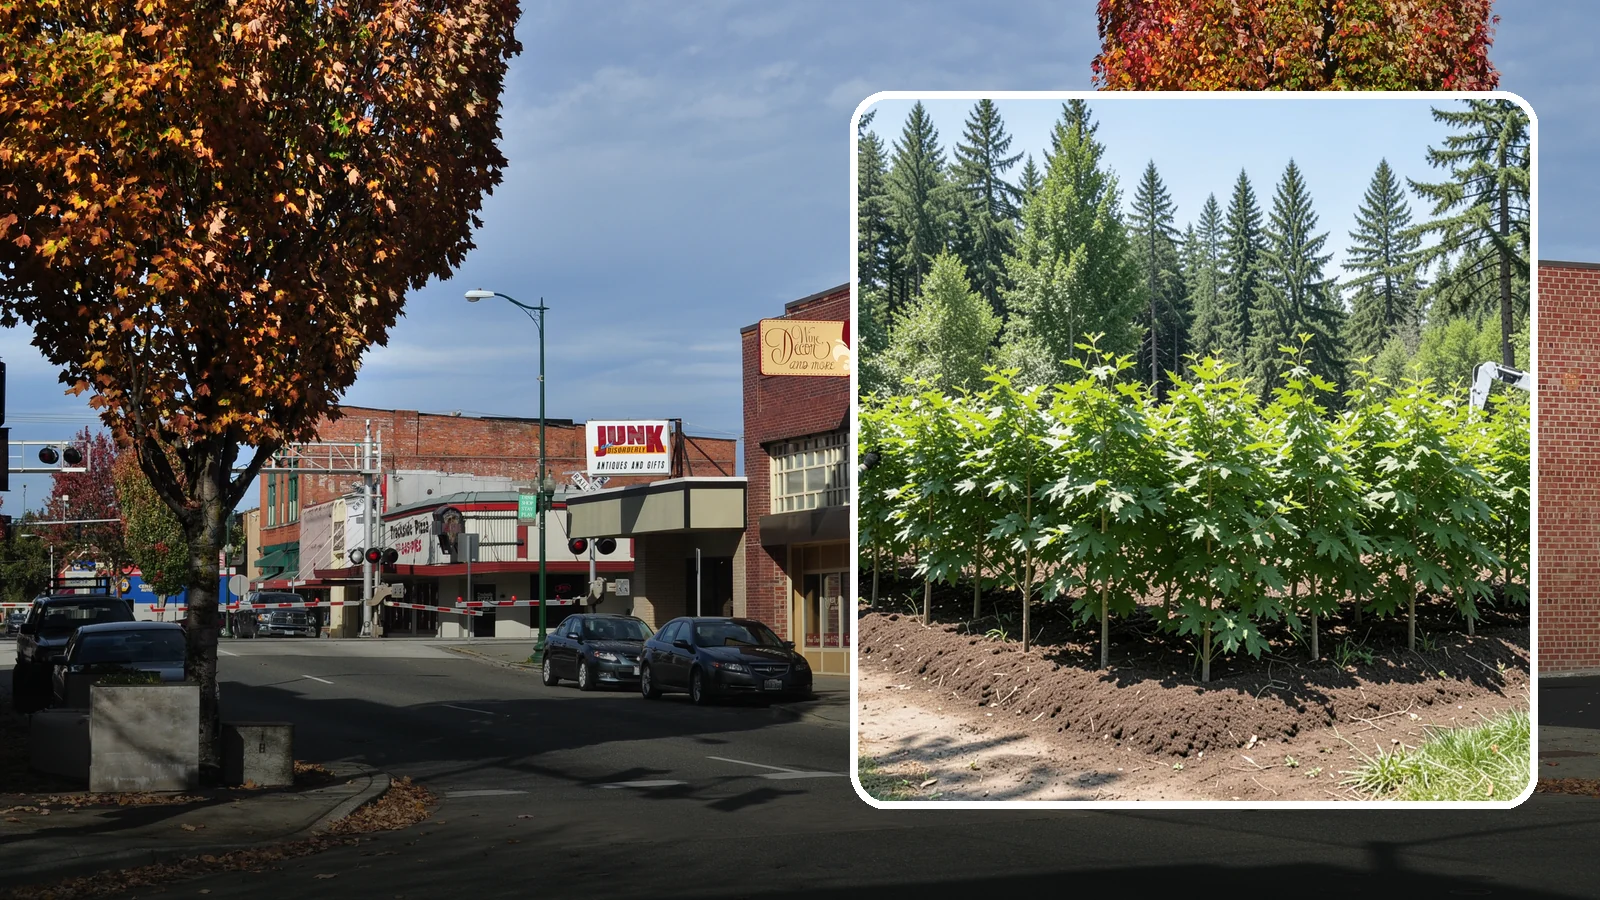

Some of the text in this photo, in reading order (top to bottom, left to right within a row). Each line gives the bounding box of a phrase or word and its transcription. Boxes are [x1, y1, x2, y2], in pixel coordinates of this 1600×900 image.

[596, 425, 666, 457] JUNK
[607, 446, 646, 454] DISORDERLY
[597, 460, 665, 470] ANTIQUES AND GIFTS
[414, 520, 429, 534] Pizza
